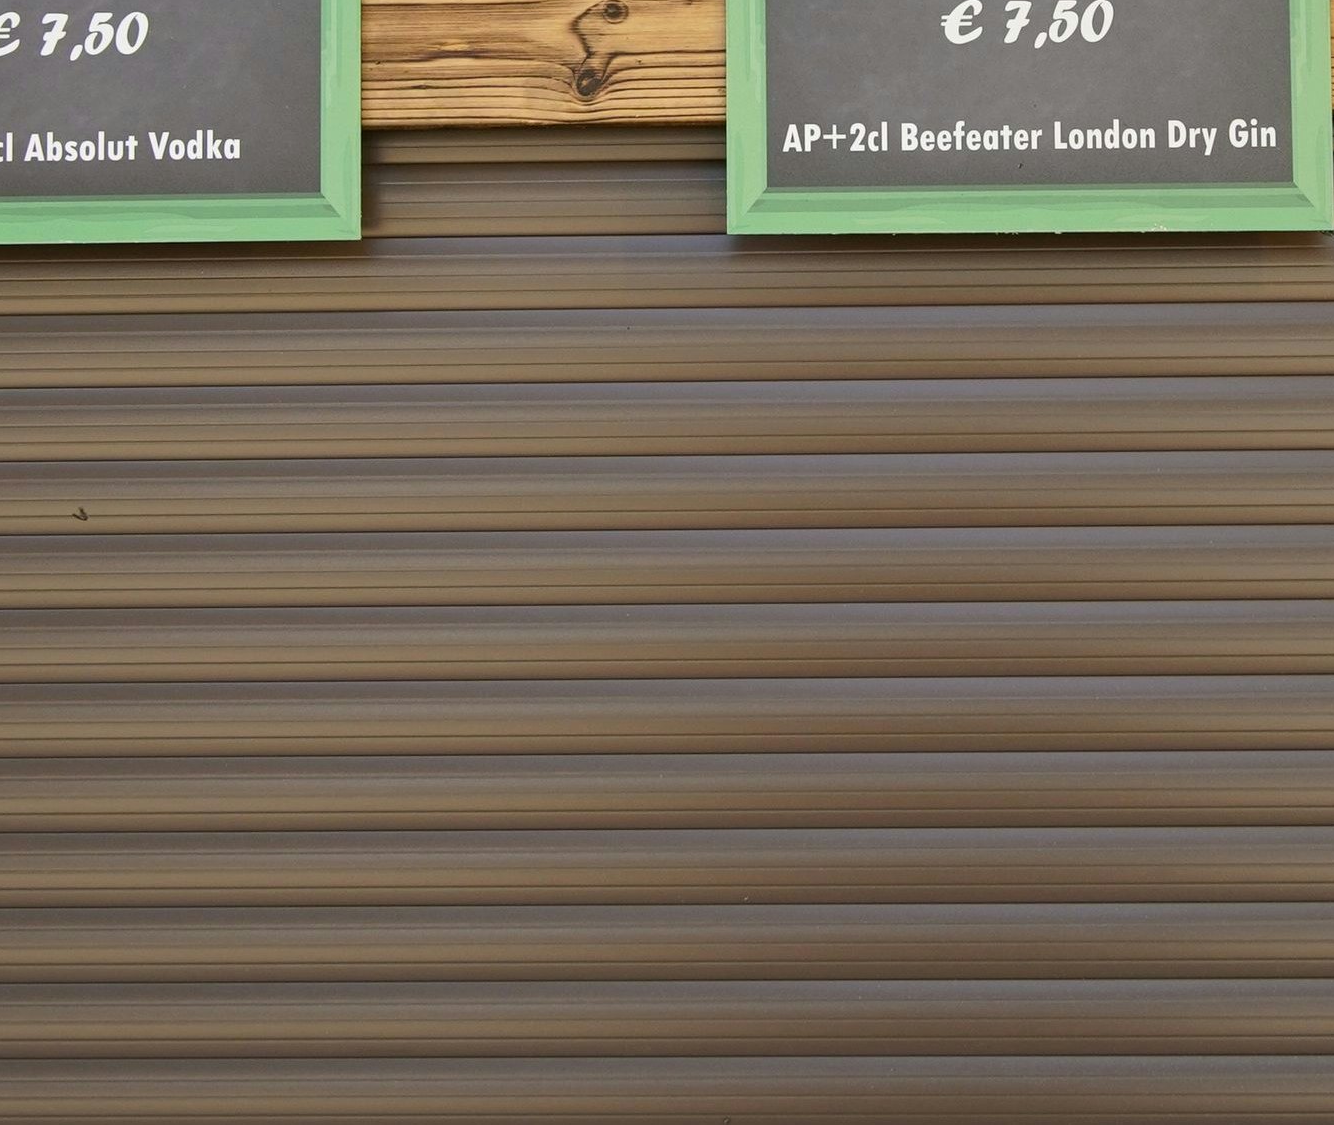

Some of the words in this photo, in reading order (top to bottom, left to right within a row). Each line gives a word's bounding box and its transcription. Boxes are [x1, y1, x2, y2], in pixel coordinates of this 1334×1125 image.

[39, 11, 149, 62] 7,50
[23, 131, 139, 162] Absolut
[147, 129, 241, 161] Vodka
[782, 120, 889, 153] AP+2cl
[900, 120, 1043, 152] Beefeater
[1053, 118, 1156, 150] London
[1167, 119, 1218, 156] Dry
[1228, 118, 1277, 149] Gin
